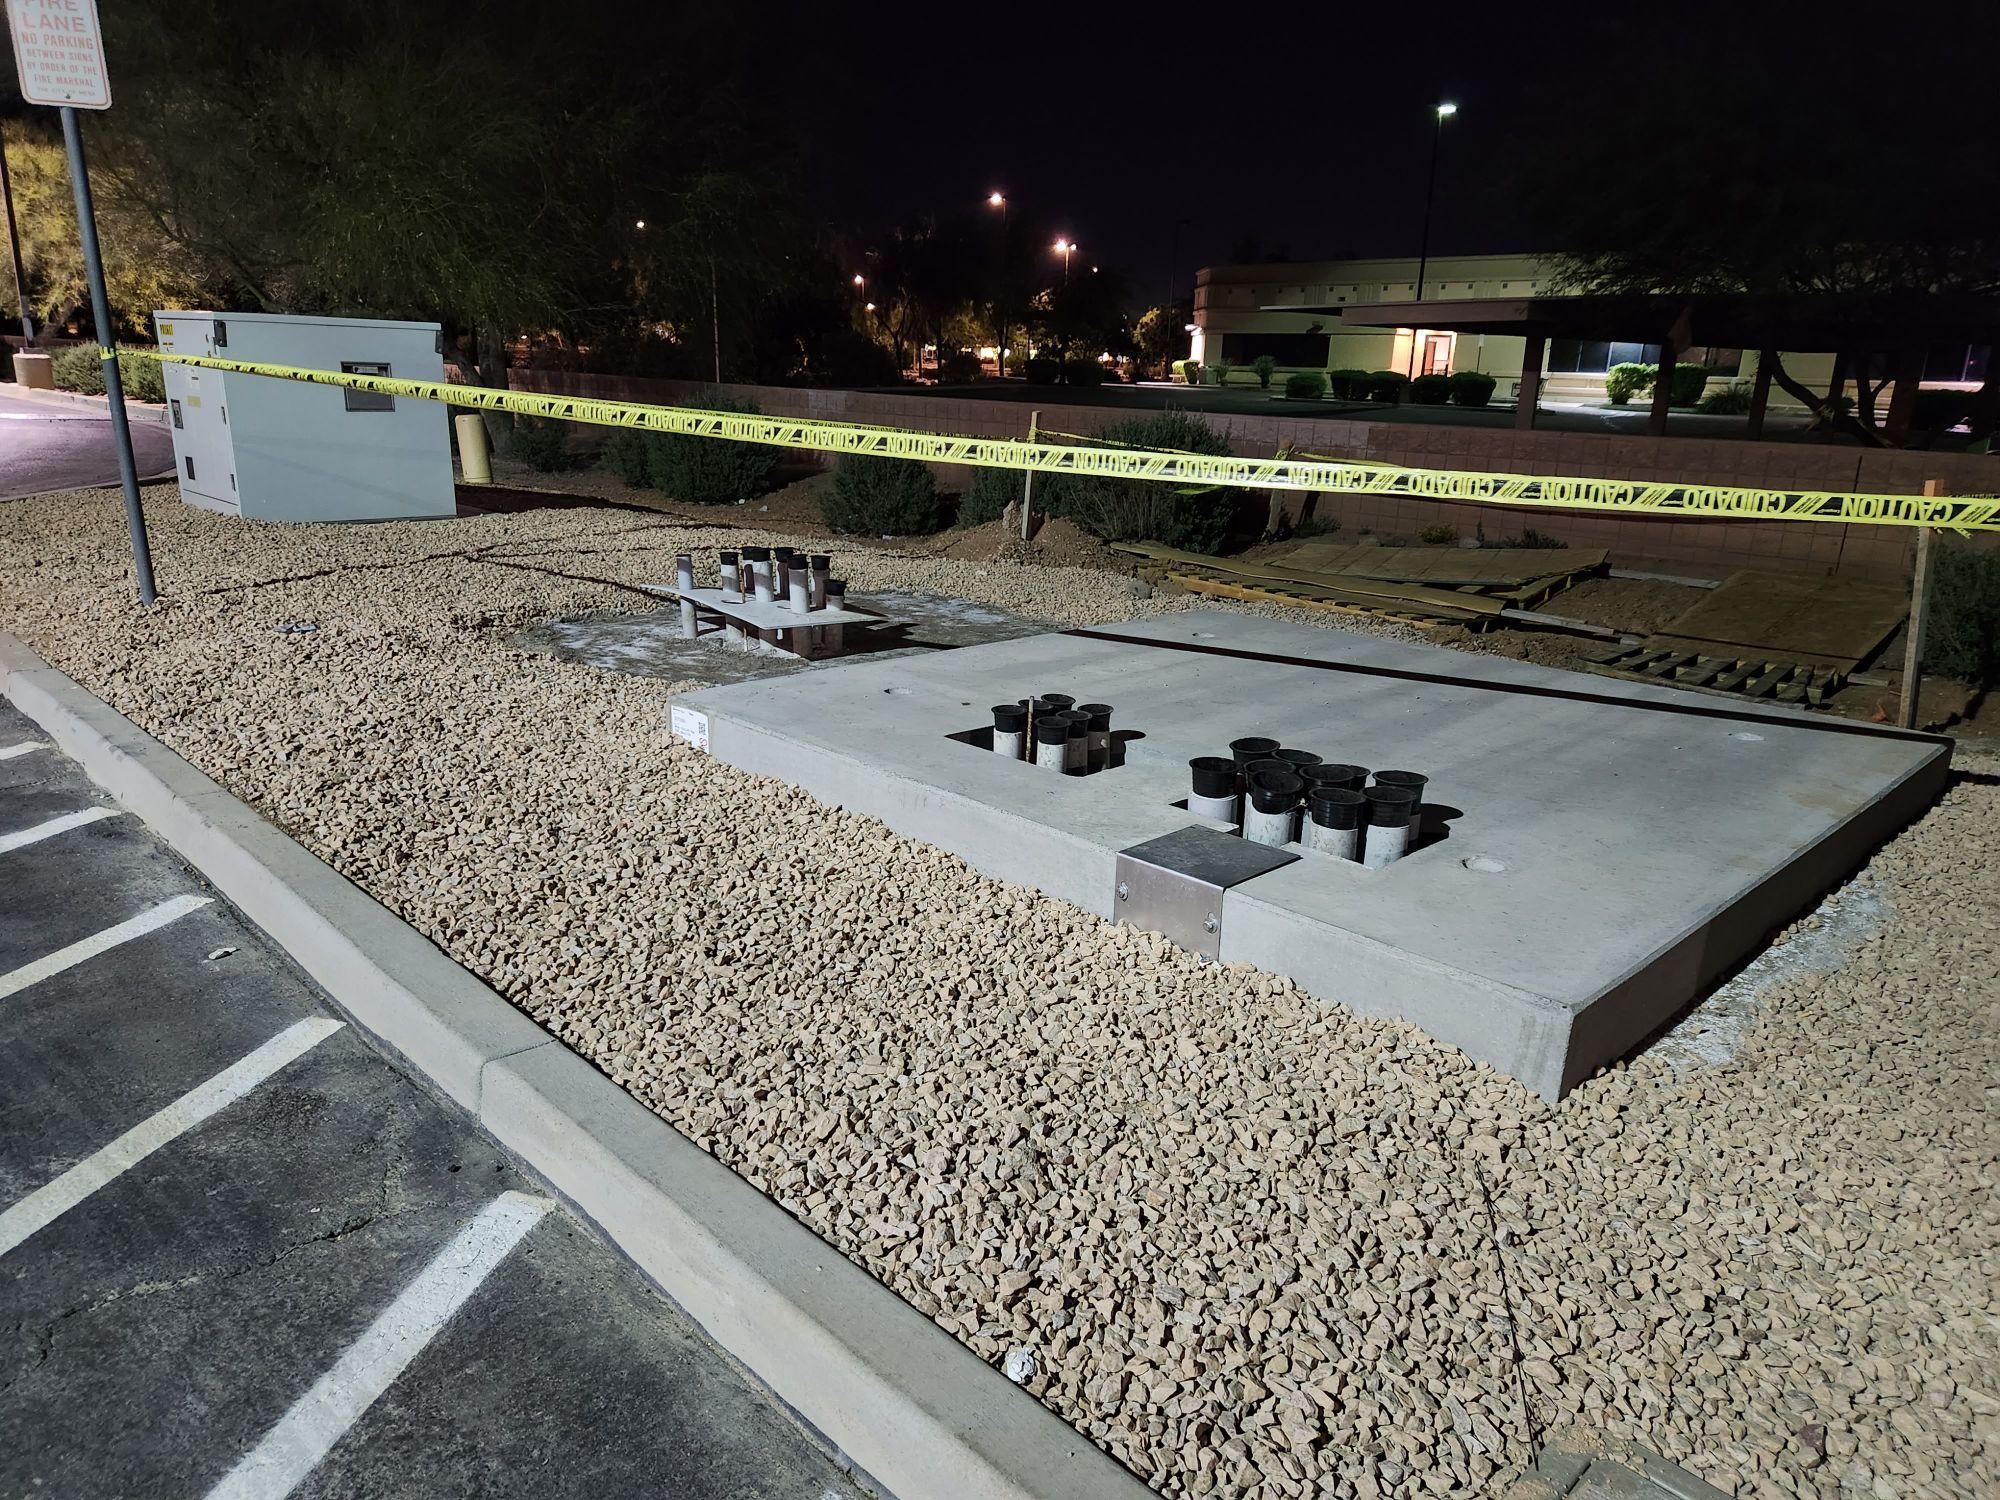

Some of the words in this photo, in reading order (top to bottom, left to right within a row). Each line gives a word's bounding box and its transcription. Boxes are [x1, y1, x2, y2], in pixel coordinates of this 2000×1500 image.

[22, 12, 86, 32] LANE
[22, 31, 37, 44] NO
[43, 34, 94, 50] PARKING
[27, 48, 65, 60] BETWEEN
[69, 52, 94, 62] SIGNS
[40, 62, 66, 72] ORDER
[572, 403, 622, 424] CAUTION
[646, 411, 697, 433] CUIDADO
[721, 419, 775, 440] CAUTION
[801, 428, 858, 449] CUIDADO
[886, 437, 947, 458] CAUTION
[976, 444, 1041, 466] CUIDADO
[1072, 452, 1141, 473] CAUTION
[1176, 459, 1250, 482] CUIDADO
[1288, 466, 1367, 490] CAUTION
[1408, 473, 1494, 496] CUIDADO
[1541, 480, 1634, 505] CAUTION
[1683, 488, 1787, 514] CUIDADO
[1841, 495, 1954, 522] CAUTION
